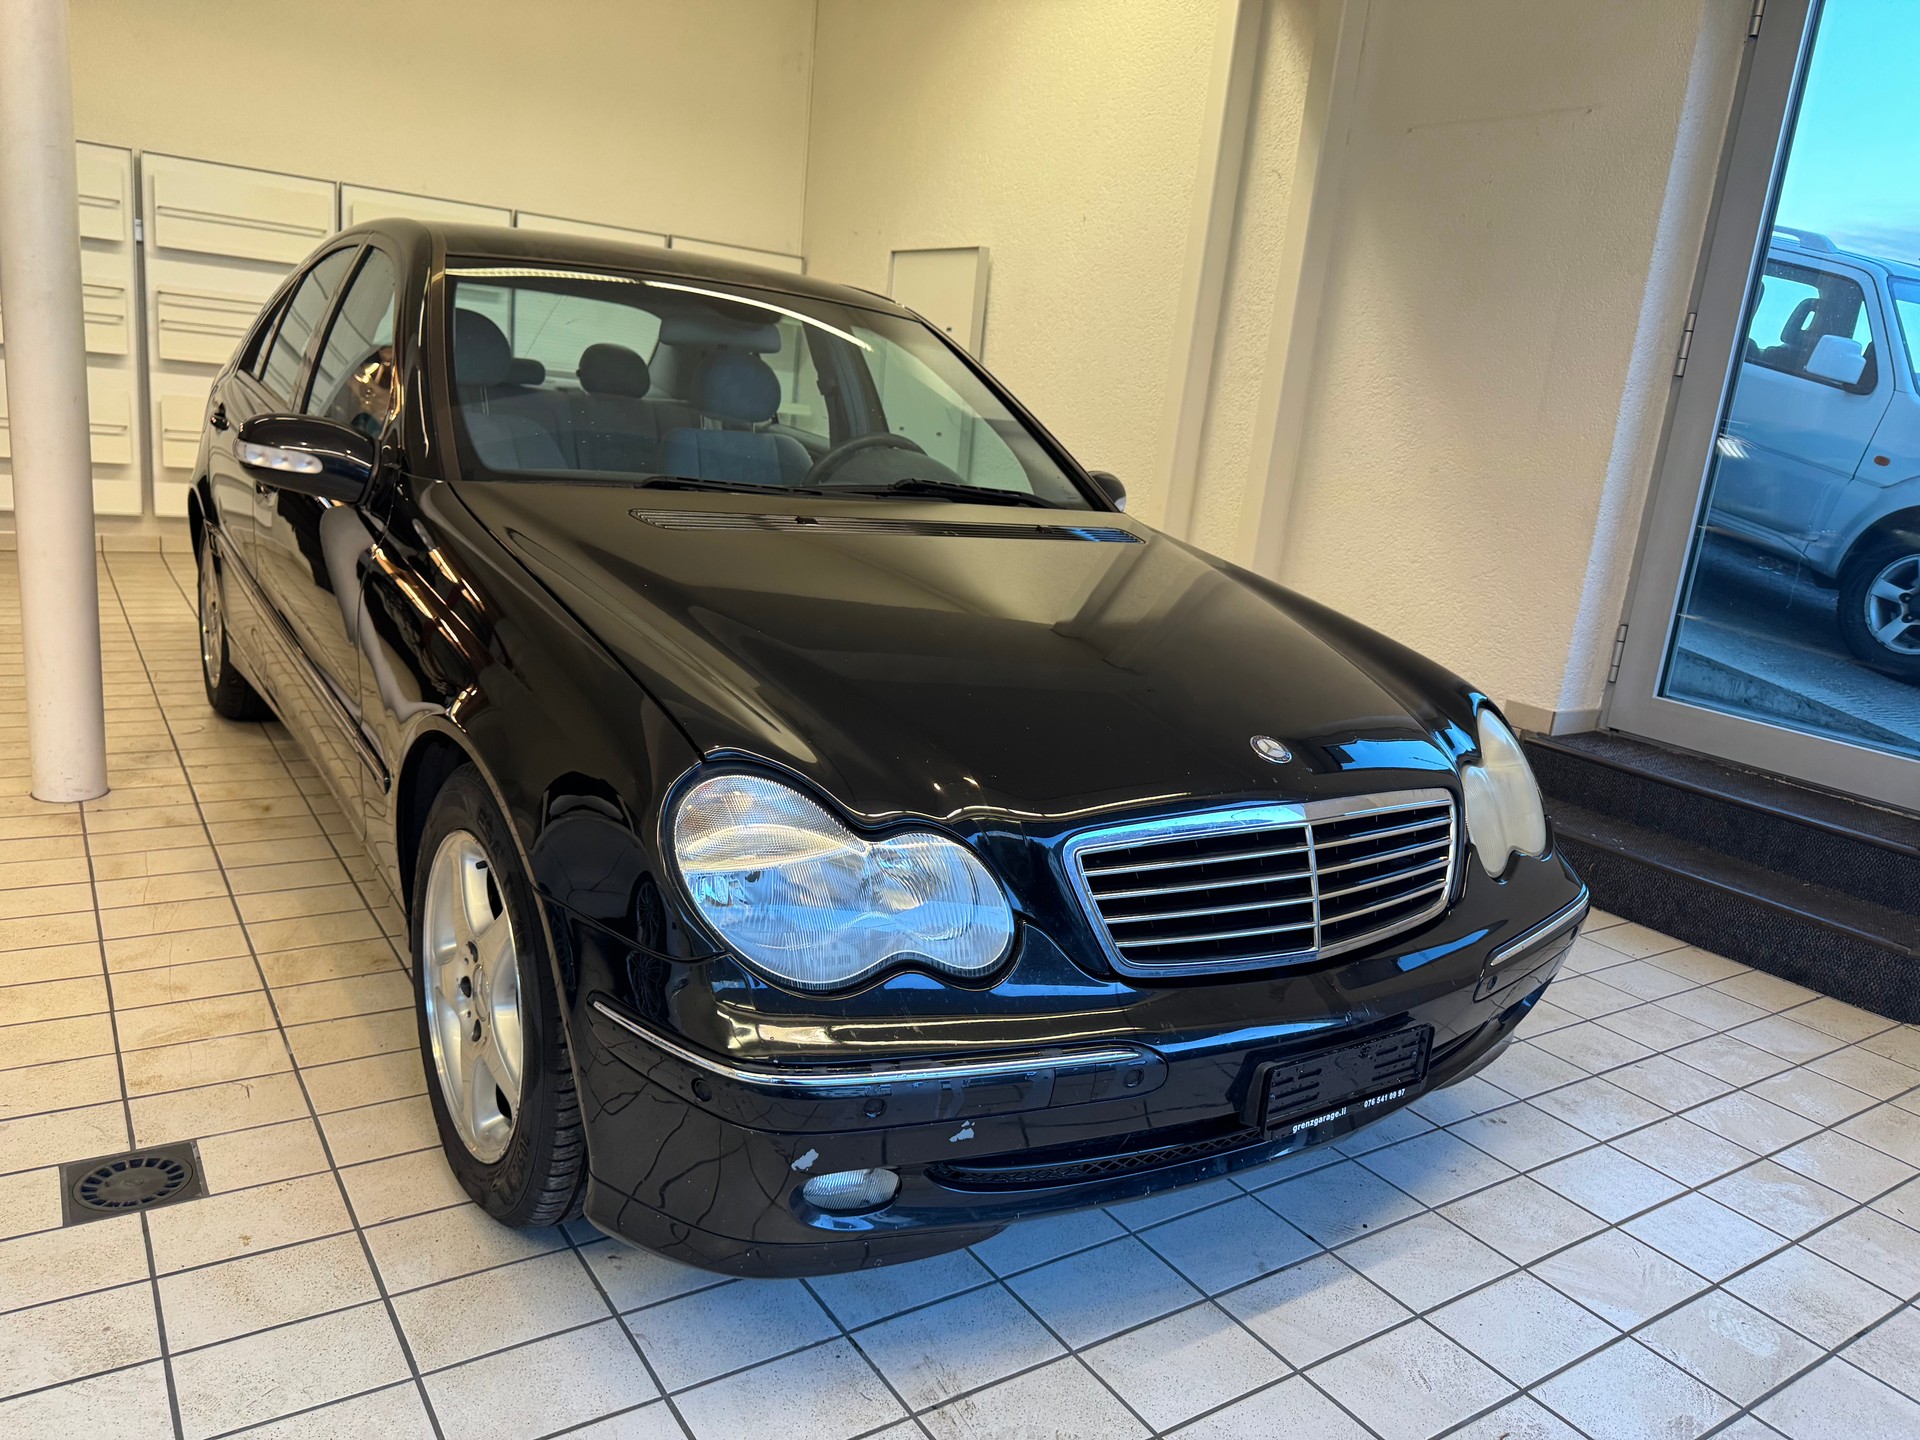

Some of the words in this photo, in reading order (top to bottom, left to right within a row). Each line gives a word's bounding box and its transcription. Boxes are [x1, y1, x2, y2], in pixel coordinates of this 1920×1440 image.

[1292, 1106, 1347, 1134] grenzgarage.li
[1363, 1098, 1375, 1108] 076
[1376, 1094, 1388, 1104] 541
[1397, 1088, 1406, 1097] 97
